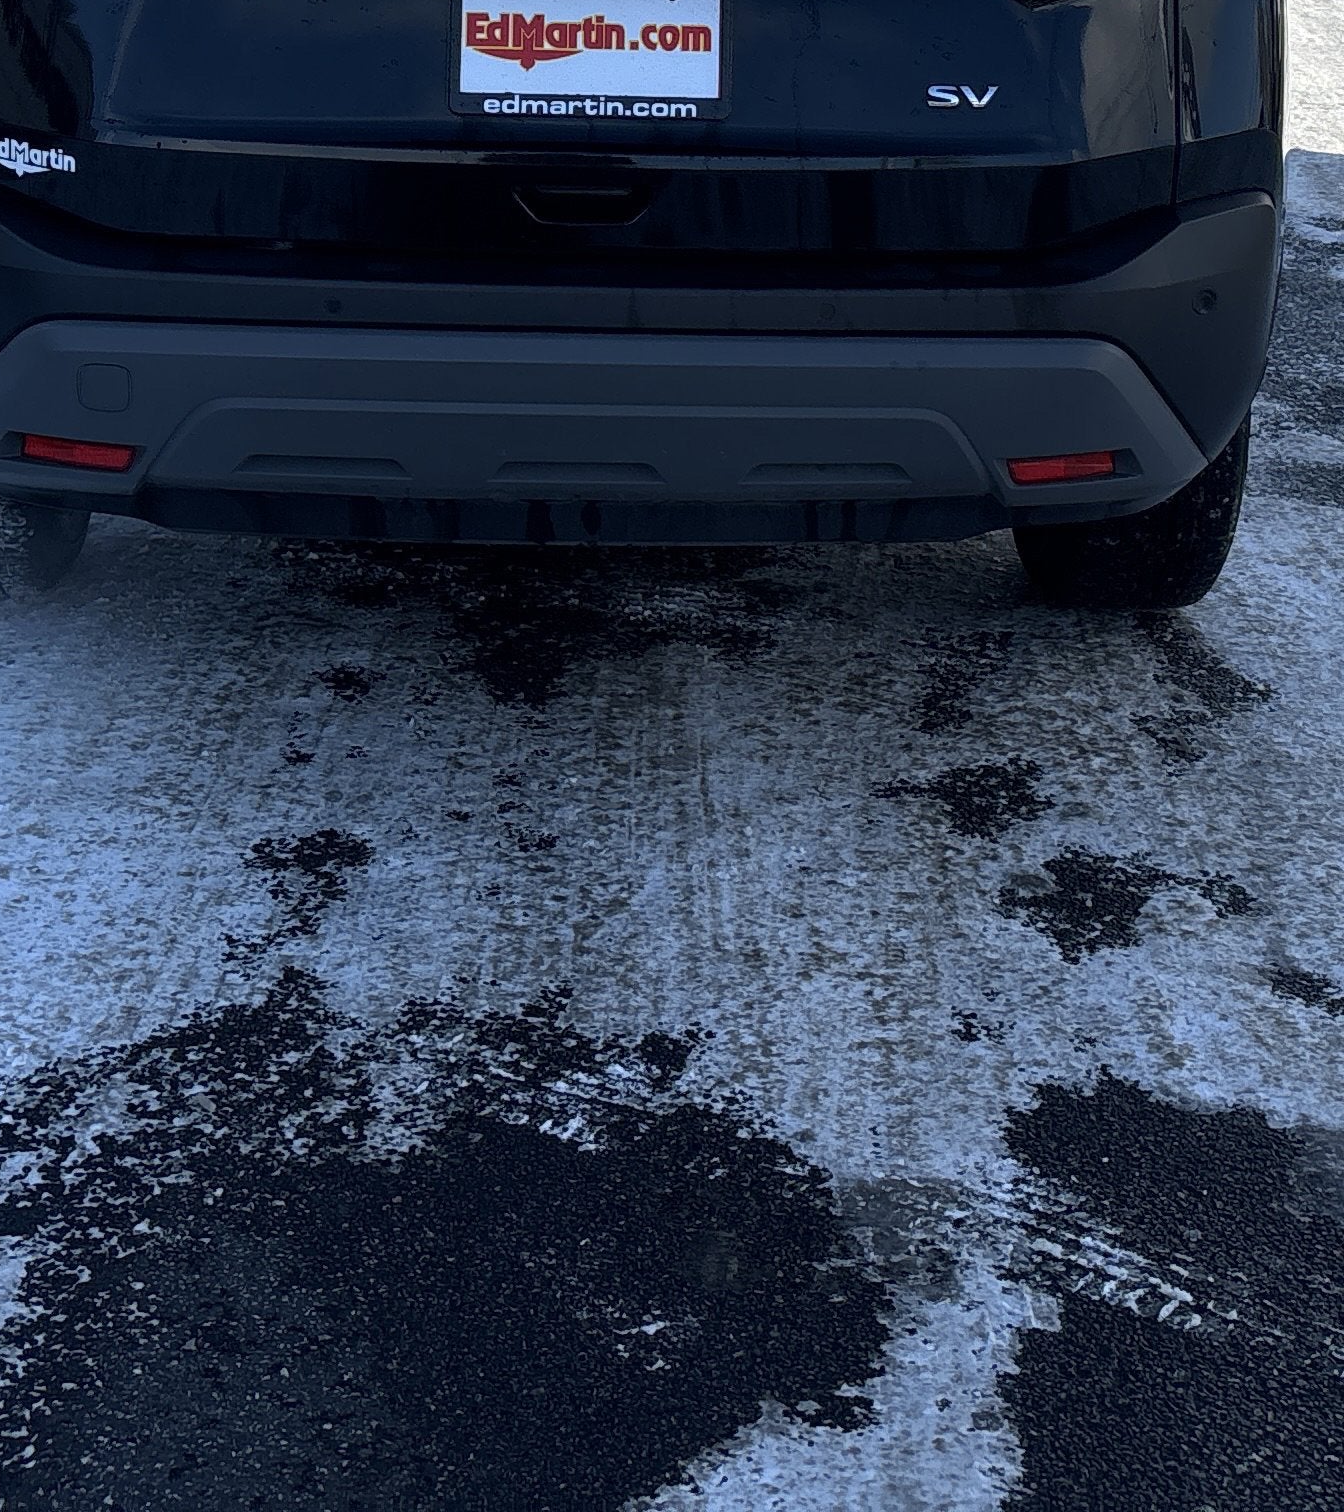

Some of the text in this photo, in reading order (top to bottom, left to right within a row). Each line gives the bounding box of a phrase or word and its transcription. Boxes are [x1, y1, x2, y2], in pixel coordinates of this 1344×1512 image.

[465, 11, 712, 56] EdMartin.com
[483, 95, 697, 119] edmartin.com
[926, 85, 999, 108] SV
